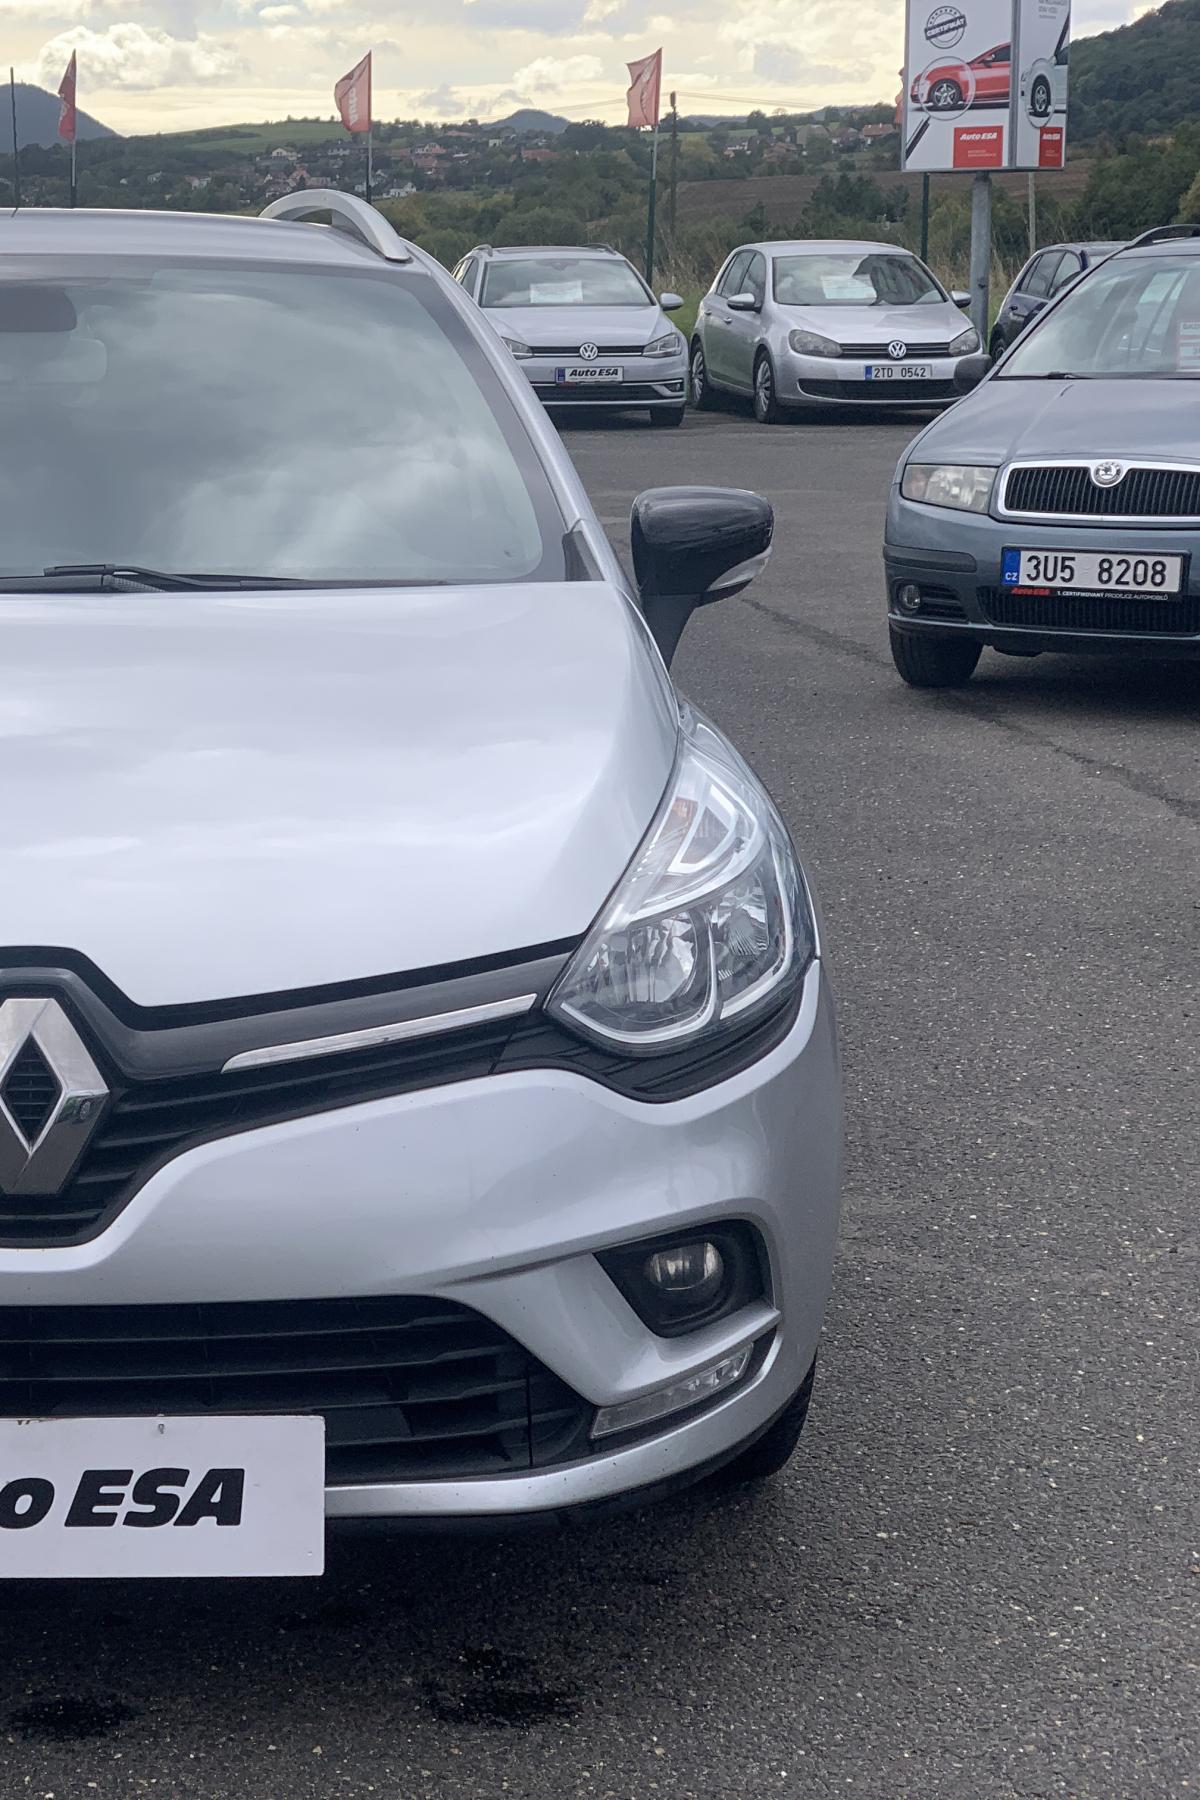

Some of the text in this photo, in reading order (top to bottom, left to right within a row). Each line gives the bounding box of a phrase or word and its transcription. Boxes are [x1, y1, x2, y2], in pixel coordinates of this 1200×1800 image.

[960, 132, 998, 141] Auto ESA
[569, 368, 619, 377] Auto ESA
[900, 367, 926, 378] 0542
[1005, 572, 1018, 581] CZ
[1026, 555, 1167, 588] 3U5 8208
[63, 1467, 246, 1528] ESA
